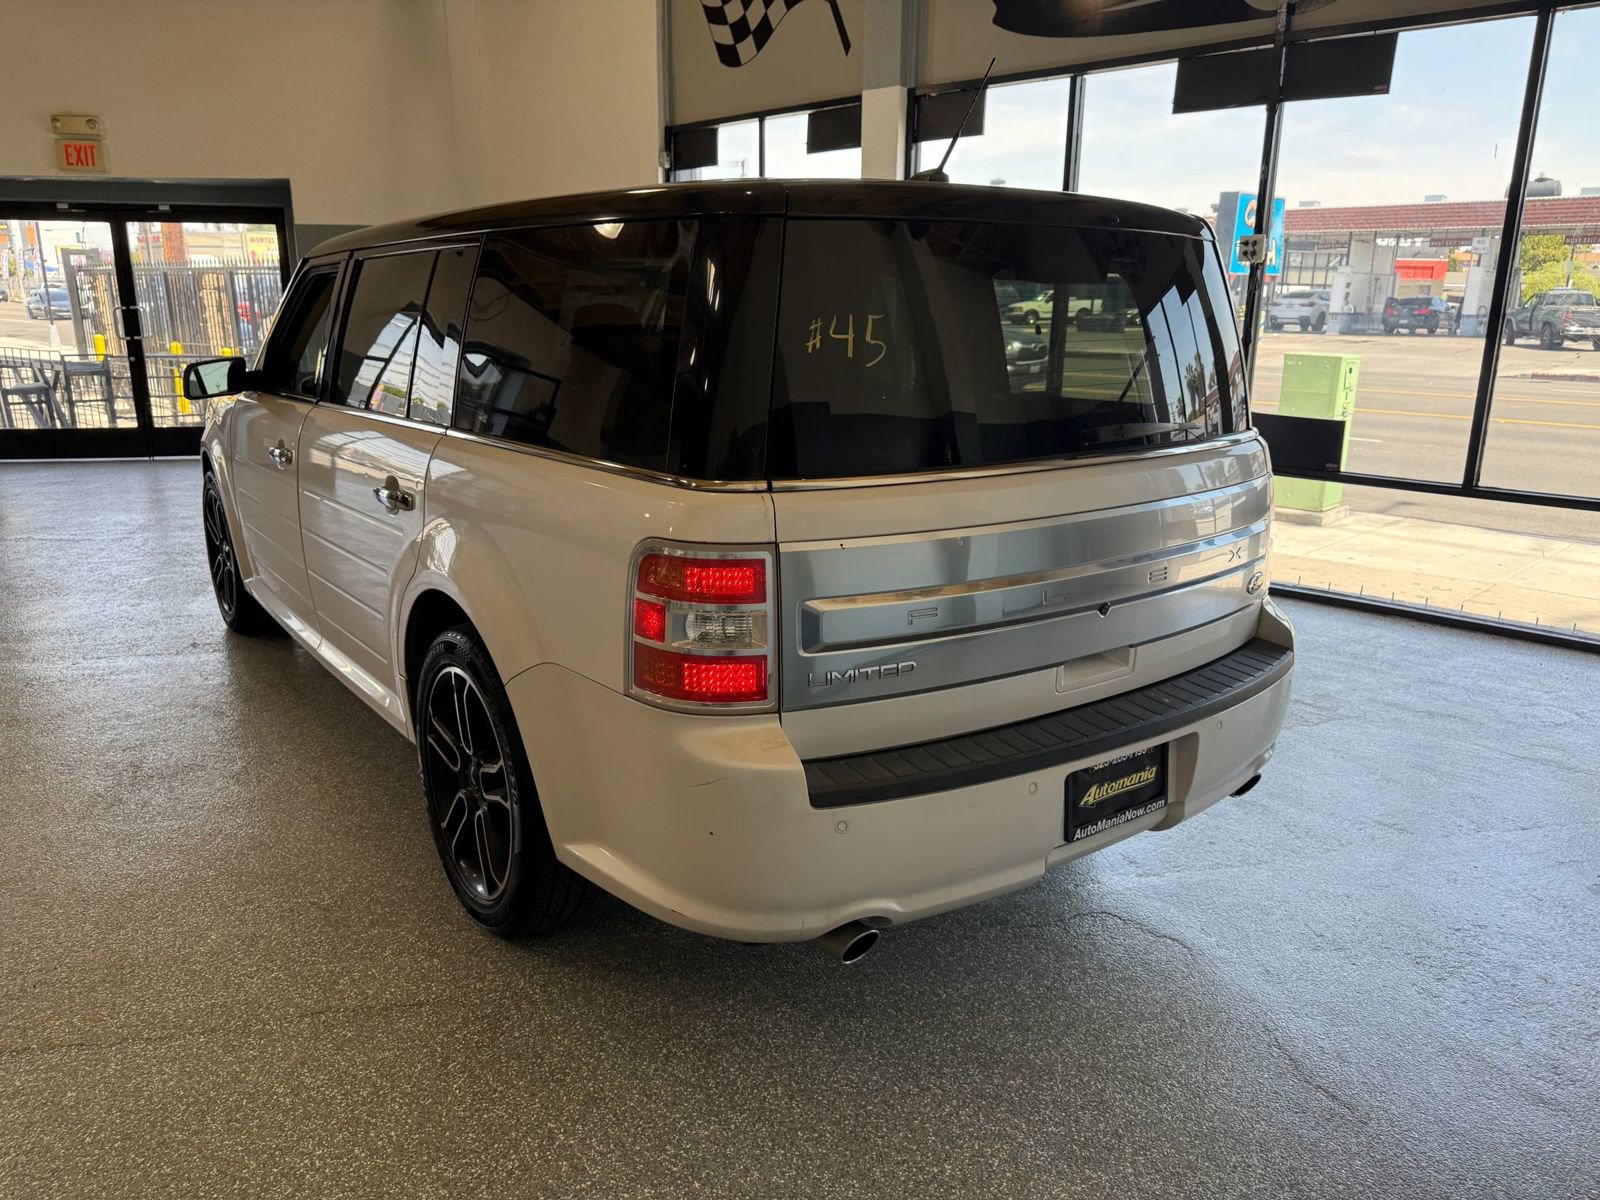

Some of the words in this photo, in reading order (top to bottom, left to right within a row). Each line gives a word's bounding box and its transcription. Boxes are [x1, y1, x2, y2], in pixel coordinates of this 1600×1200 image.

[64, 143, 95, 167] EXIT
[805, 313, 886, 367] #45
[808, 660, 917, 687] LIMITED
[1079, 765, 1158, 807] Automania
[1073, 799, 1166, 841] AutoManiaNow.com
